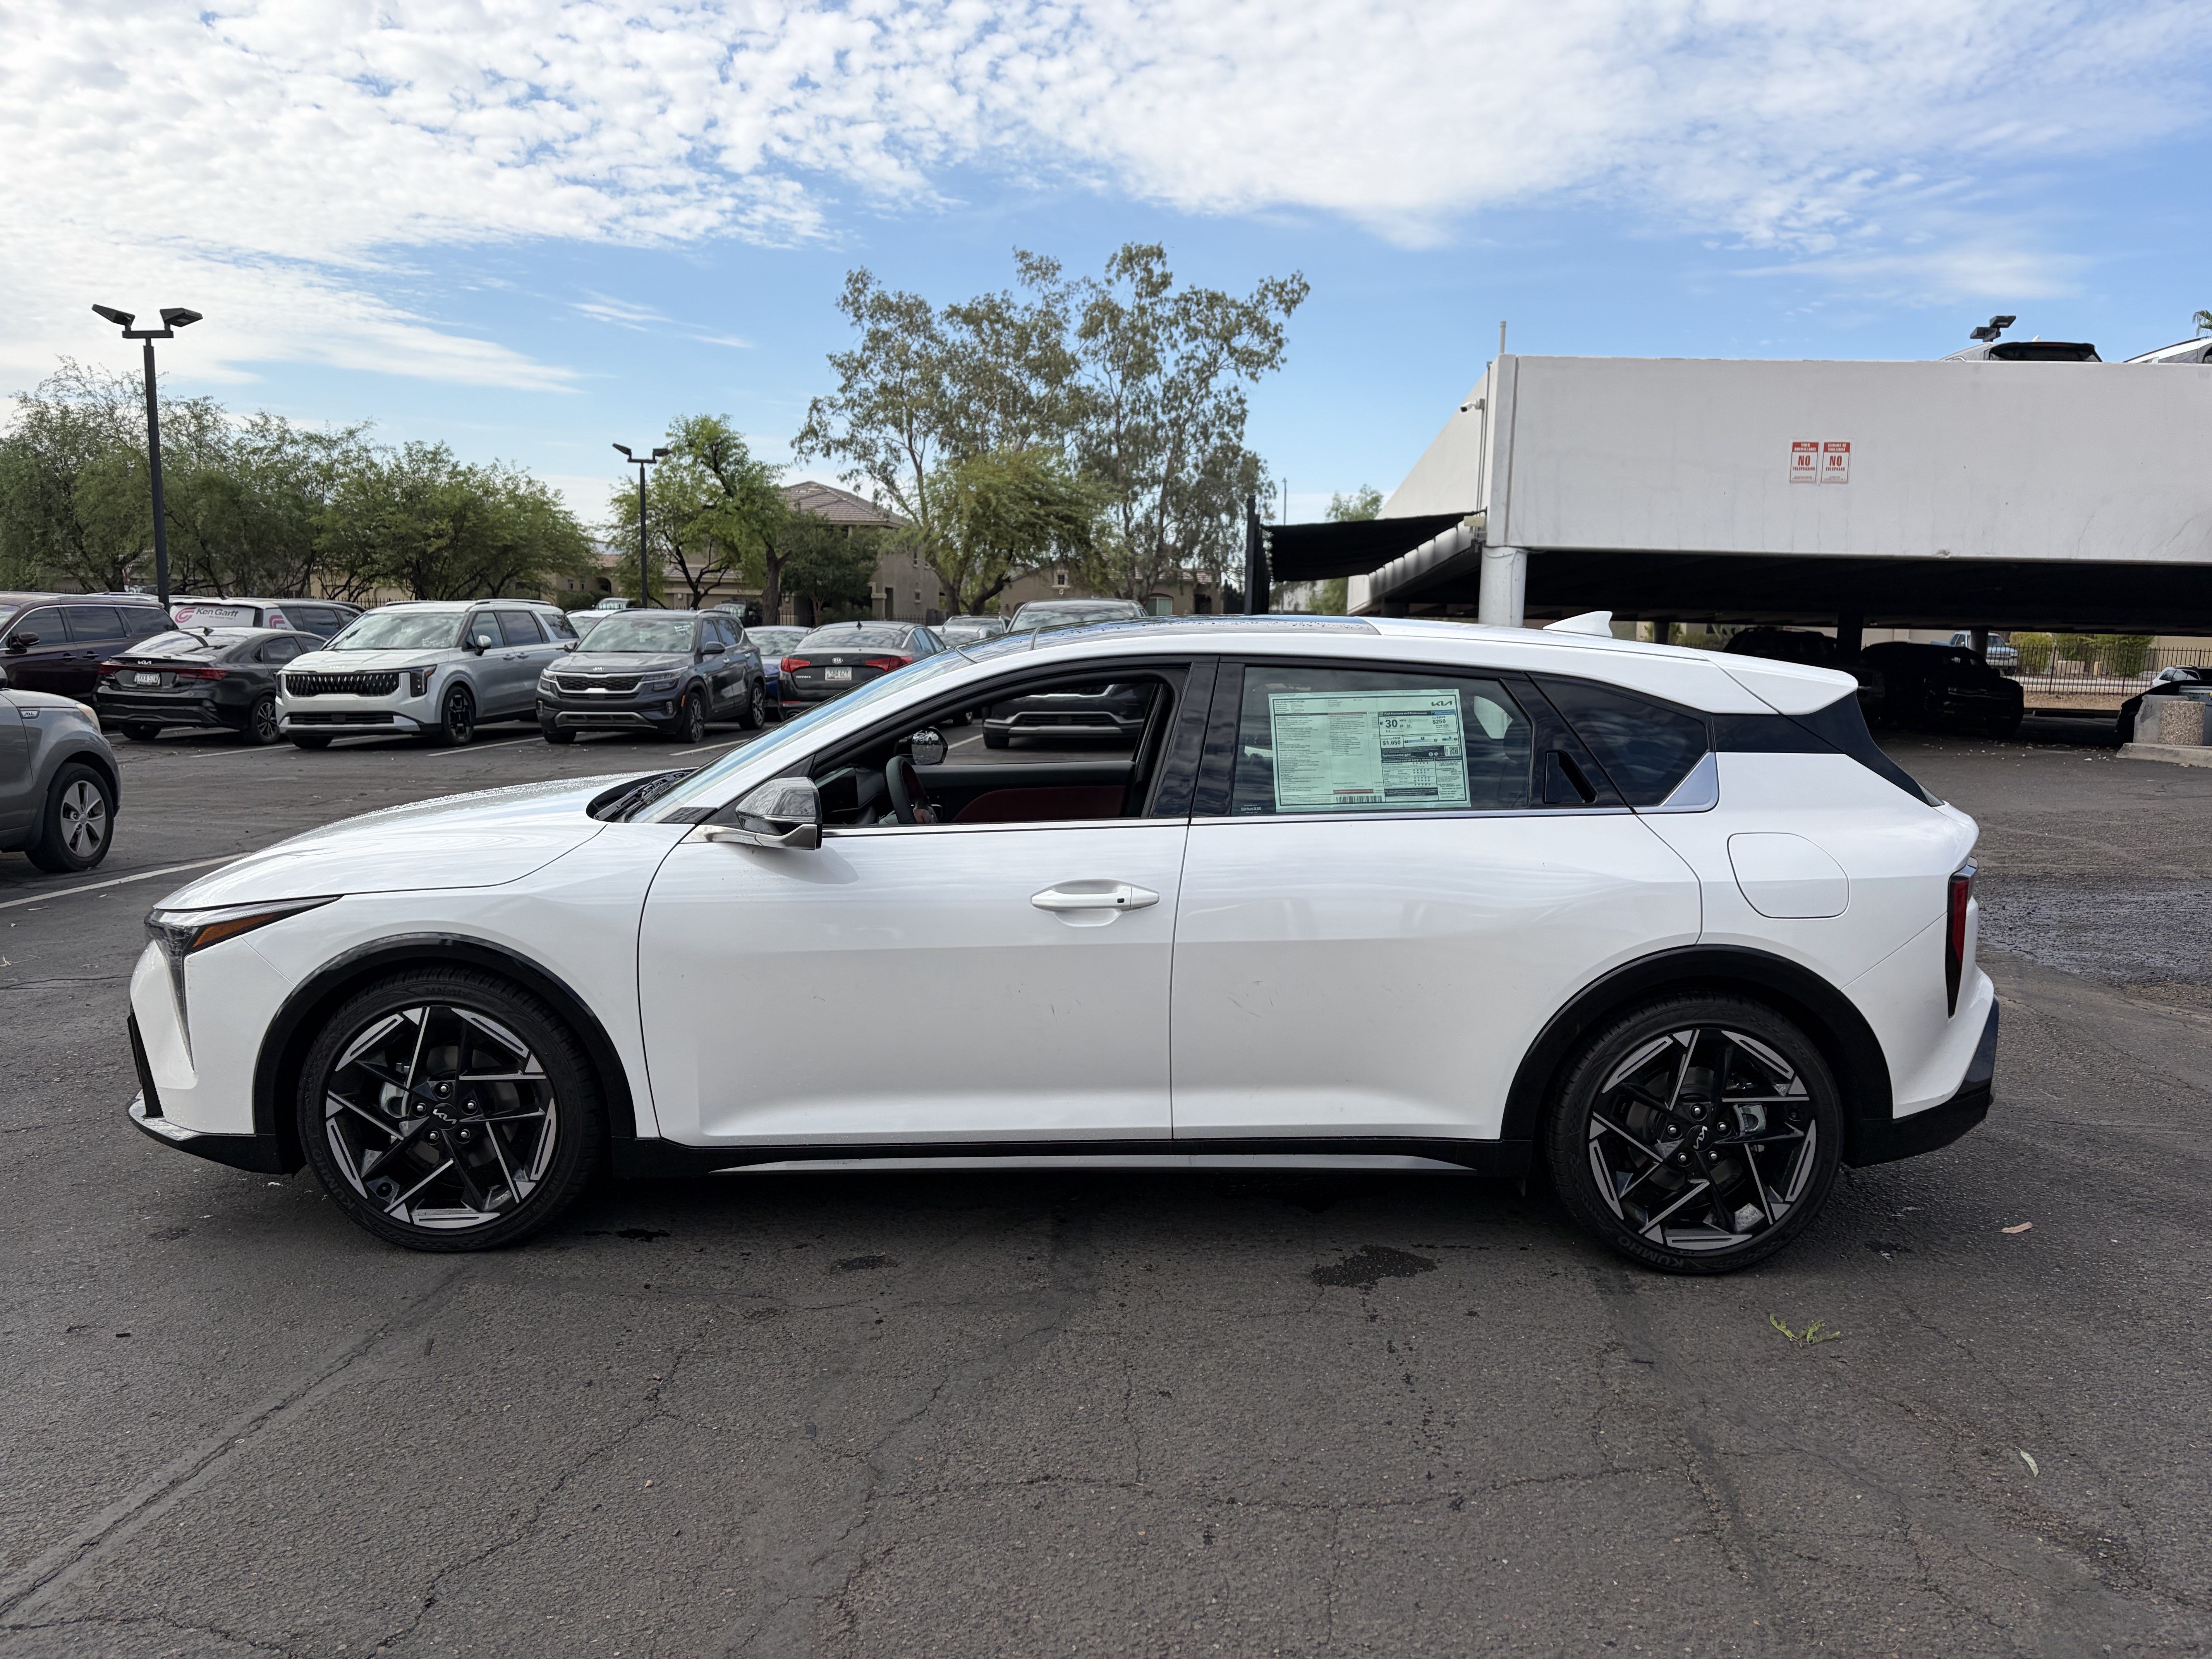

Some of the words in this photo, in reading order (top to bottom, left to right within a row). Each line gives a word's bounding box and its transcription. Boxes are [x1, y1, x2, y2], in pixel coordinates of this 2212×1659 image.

[1798, 455, 1810, 466] NO
[1829, 455, 1842, 466] NO
[215, 609, 239, 617] Garff
[1385, 719, 1398, 728] 30
[433, 1109, 457, 1124] KIA
[1693, 1125, 1708, 1149] KIA
[313, 1149, 356, 1209] KUMHO
[1618, 1236, 1684, 1267] KUMHO
